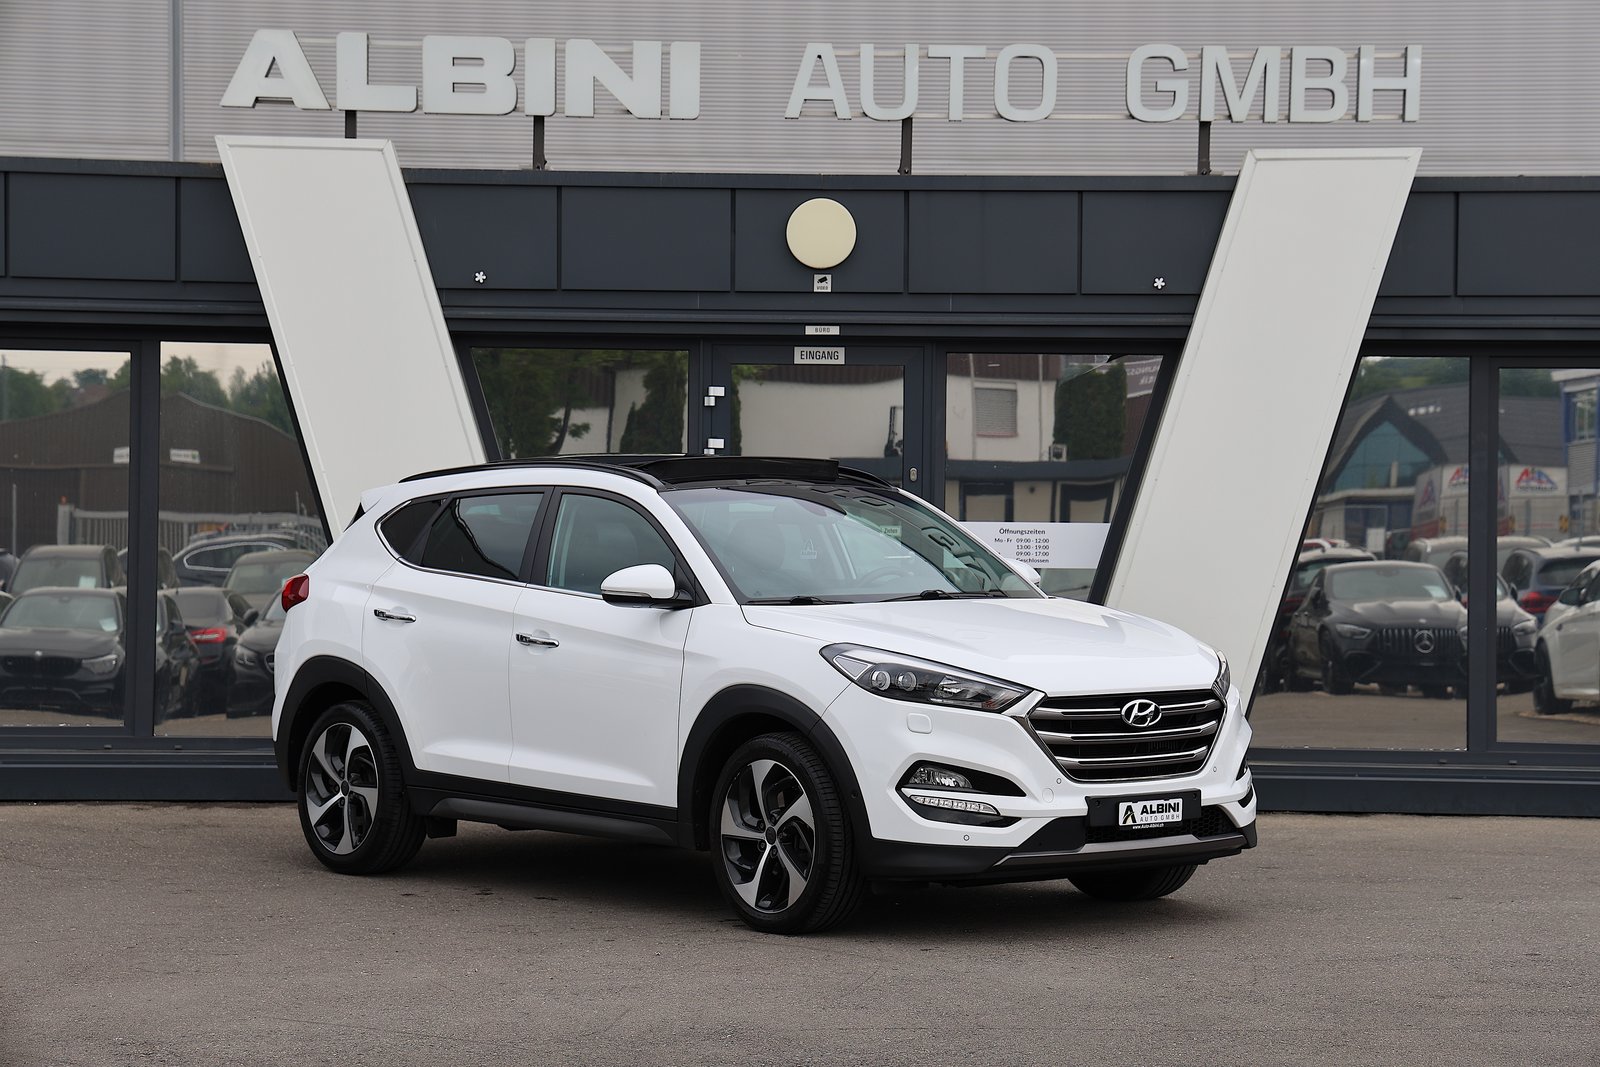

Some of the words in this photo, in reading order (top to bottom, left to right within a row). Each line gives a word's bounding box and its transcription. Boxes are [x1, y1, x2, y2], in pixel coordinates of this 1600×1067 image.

[219, 28, 700, 121] ALBINI
[784, 42, 1058, 122] AUTO
[1125, 43, 1423, 123] GMBH
[800, 350, 840, 361] EINGANG
[998, 527, 1046, 536] Öffnungszeiten
[1140, 802, 1180, 815] ALBINI
